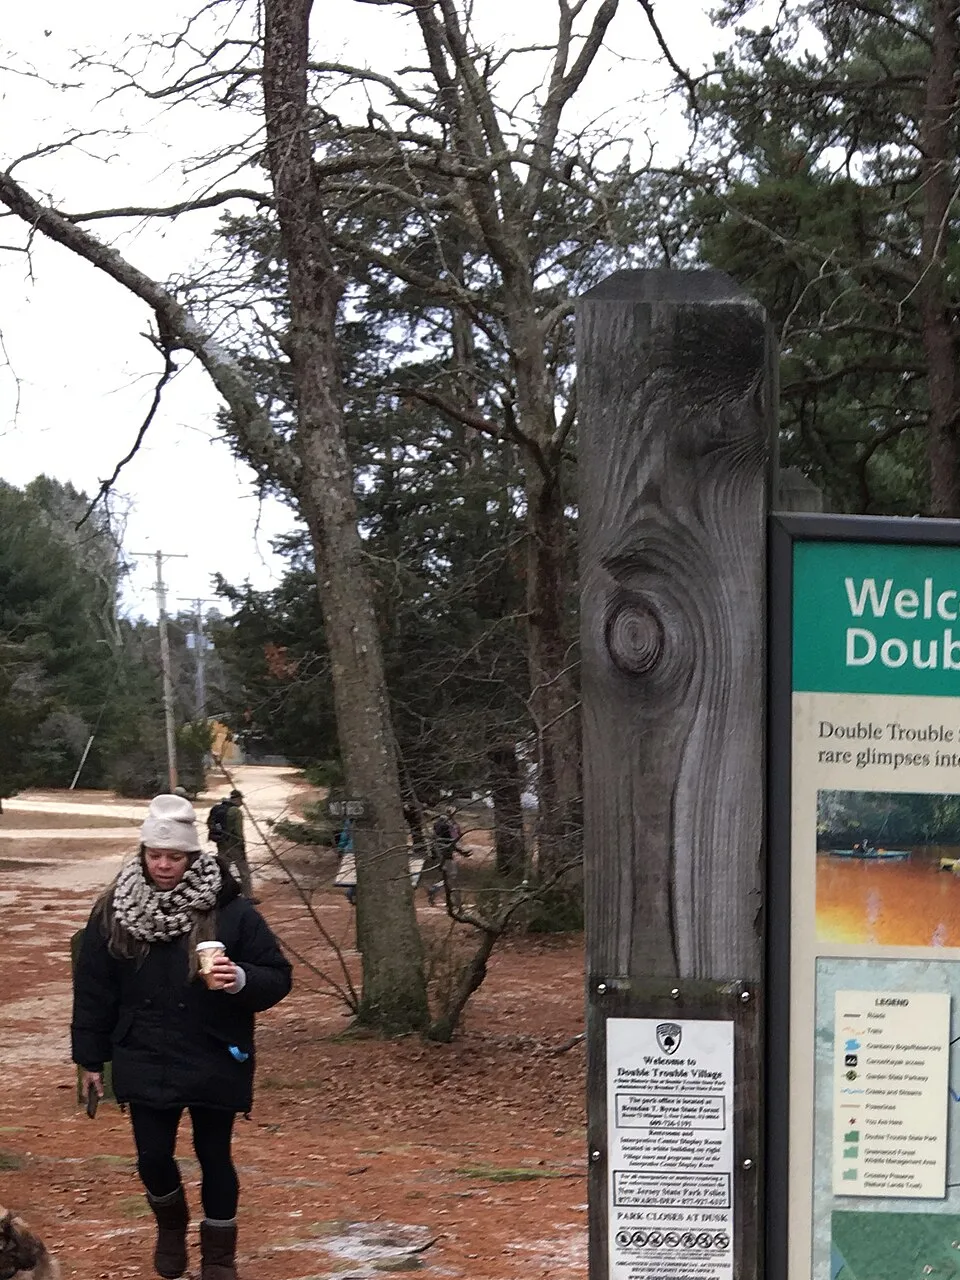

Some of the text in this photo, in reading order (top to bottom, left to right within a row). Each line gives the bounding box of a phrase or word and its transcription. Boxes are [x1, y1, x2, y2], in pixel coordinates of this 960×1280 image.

[818, 721, 883, 740] Double
[885, 723, 954, 742] Trouble
[817, 751, 852, 763] rare
[855, 748, 931, 770] glimpses
[875, 998, 910, 1007] LEGEND
[643, 1056, 697, 1066] Welcome to
[617, 1067, 722, 1080] Double Trouble Village
[617, 1212, 728, 1222] PARK CLOSES AT DUSK
